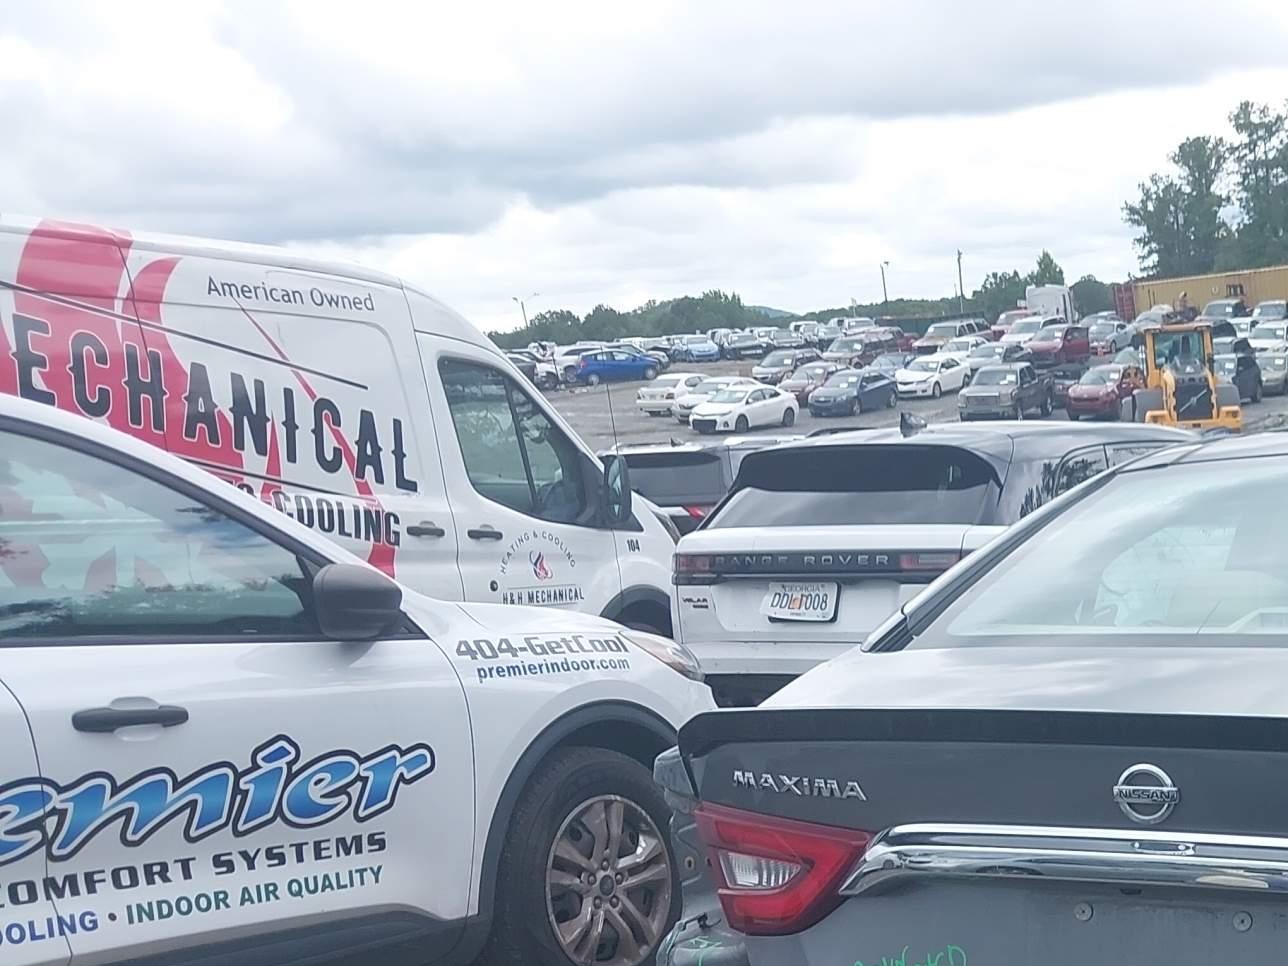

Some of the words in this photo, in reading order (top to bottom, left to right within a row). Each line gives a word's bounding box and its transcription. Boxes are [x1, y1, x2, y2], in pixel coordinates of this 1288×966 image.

[207, 275, 304, 305] American
[310, 287, 375, 311] Owned
[626, 539, 641, 552] 104
[714, 556, 789, 565] RANGE
[803, 554, 890, 566] ROVER
[527, 588, 585, 604] MECHANICAL
[456, 635, 631, 661] 404-GetCool
[477, 657, 631, 684] premierindoor.com
[733, 770, 867, 800] MAXIMA
[1119, 788, 1171, 802] NISSAN
[0, 857, 196, 908] OMFORT
[212, 831, 387, 876] SYSTEMS
[0, 910, 99, 946] OLING
[126, 890, 231, 925] INDOOR
[239, 882, 280, 908] AIR
[288, 865, 383, 898] QUALITY
